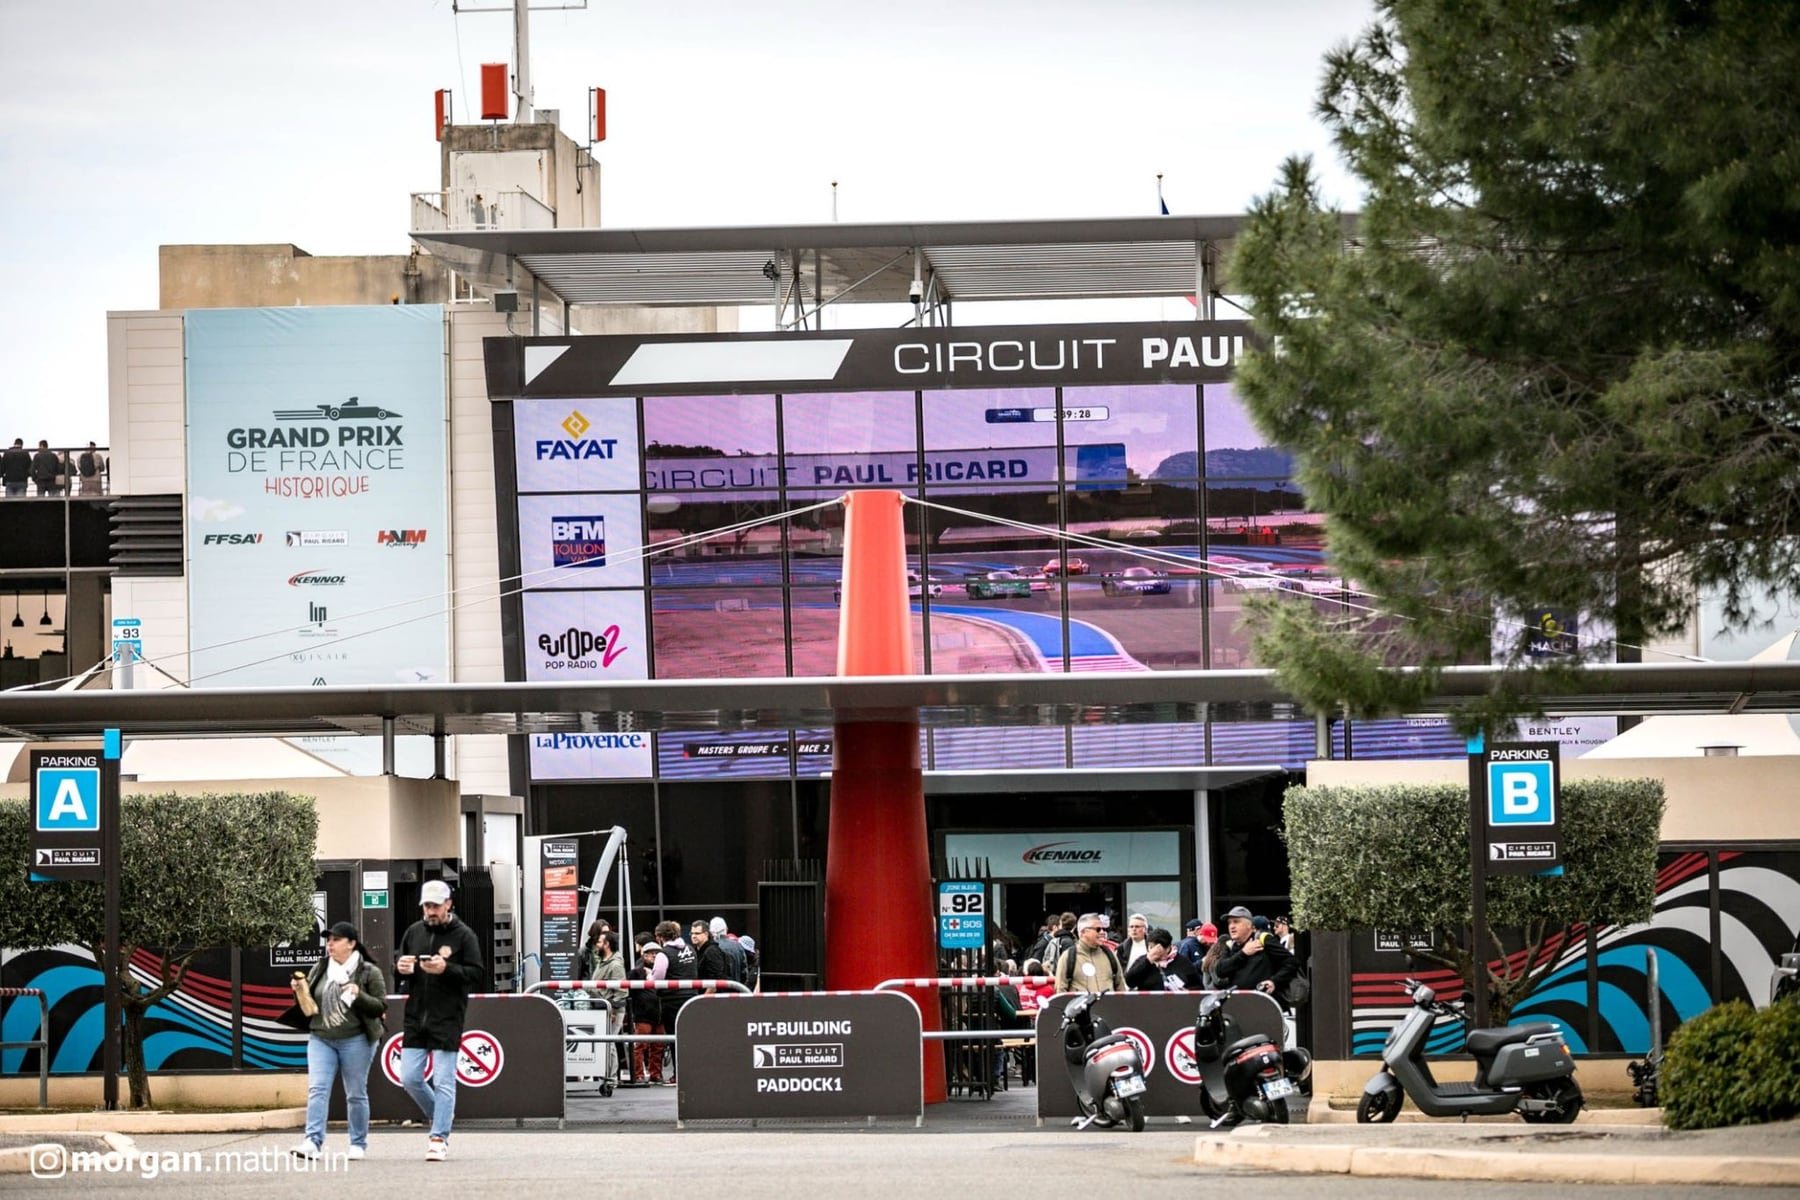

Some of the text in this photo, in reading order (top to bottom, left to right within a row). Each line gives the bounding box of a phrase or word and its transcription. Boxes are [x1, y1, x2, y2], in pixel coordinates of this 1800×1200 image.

[894, 339, 1116, 374] CIRCUIT
[227, 425, 404, 449] GRAND PRIX
[536, 439, 617, 460] FAYAT
[228, 449, 404, 472] DE FRANCE
[814, 464, 892, 484] PAUL
[906, 459, 1028, 482] RICARD
[265, 476, 369, 498] HISTORIQUE
[553, 521, 603, 540] BFM
[203, 533, 258, 545] FFSA
[554, 544, 604, 555] TOULON
[293, 575, 346, 584] KENNOL
[122, 628, 140, 639] 93
[545, 660, 598, 669] POP RADIO
[1529, 727, 1581, 736] BENTLEY
[698, 746, 734, 754] MASTERS
[737, 745, 769, 753] GROUPE
[1490, 749, 1550, 760] PARKING
[40, 756, 97, 767] PARKING
[1502, 771, 1539, 815] B
[48, 778, 88, 821] A
[1029, 850, 1103, 860] KENNOL
[952, 894, 982, 913] 92
[962, 920, 983, 929] SOS
[747, 1021, 852, 1036] PIT-BUILDING
[779, 1056, 802, 1064] PAUL
